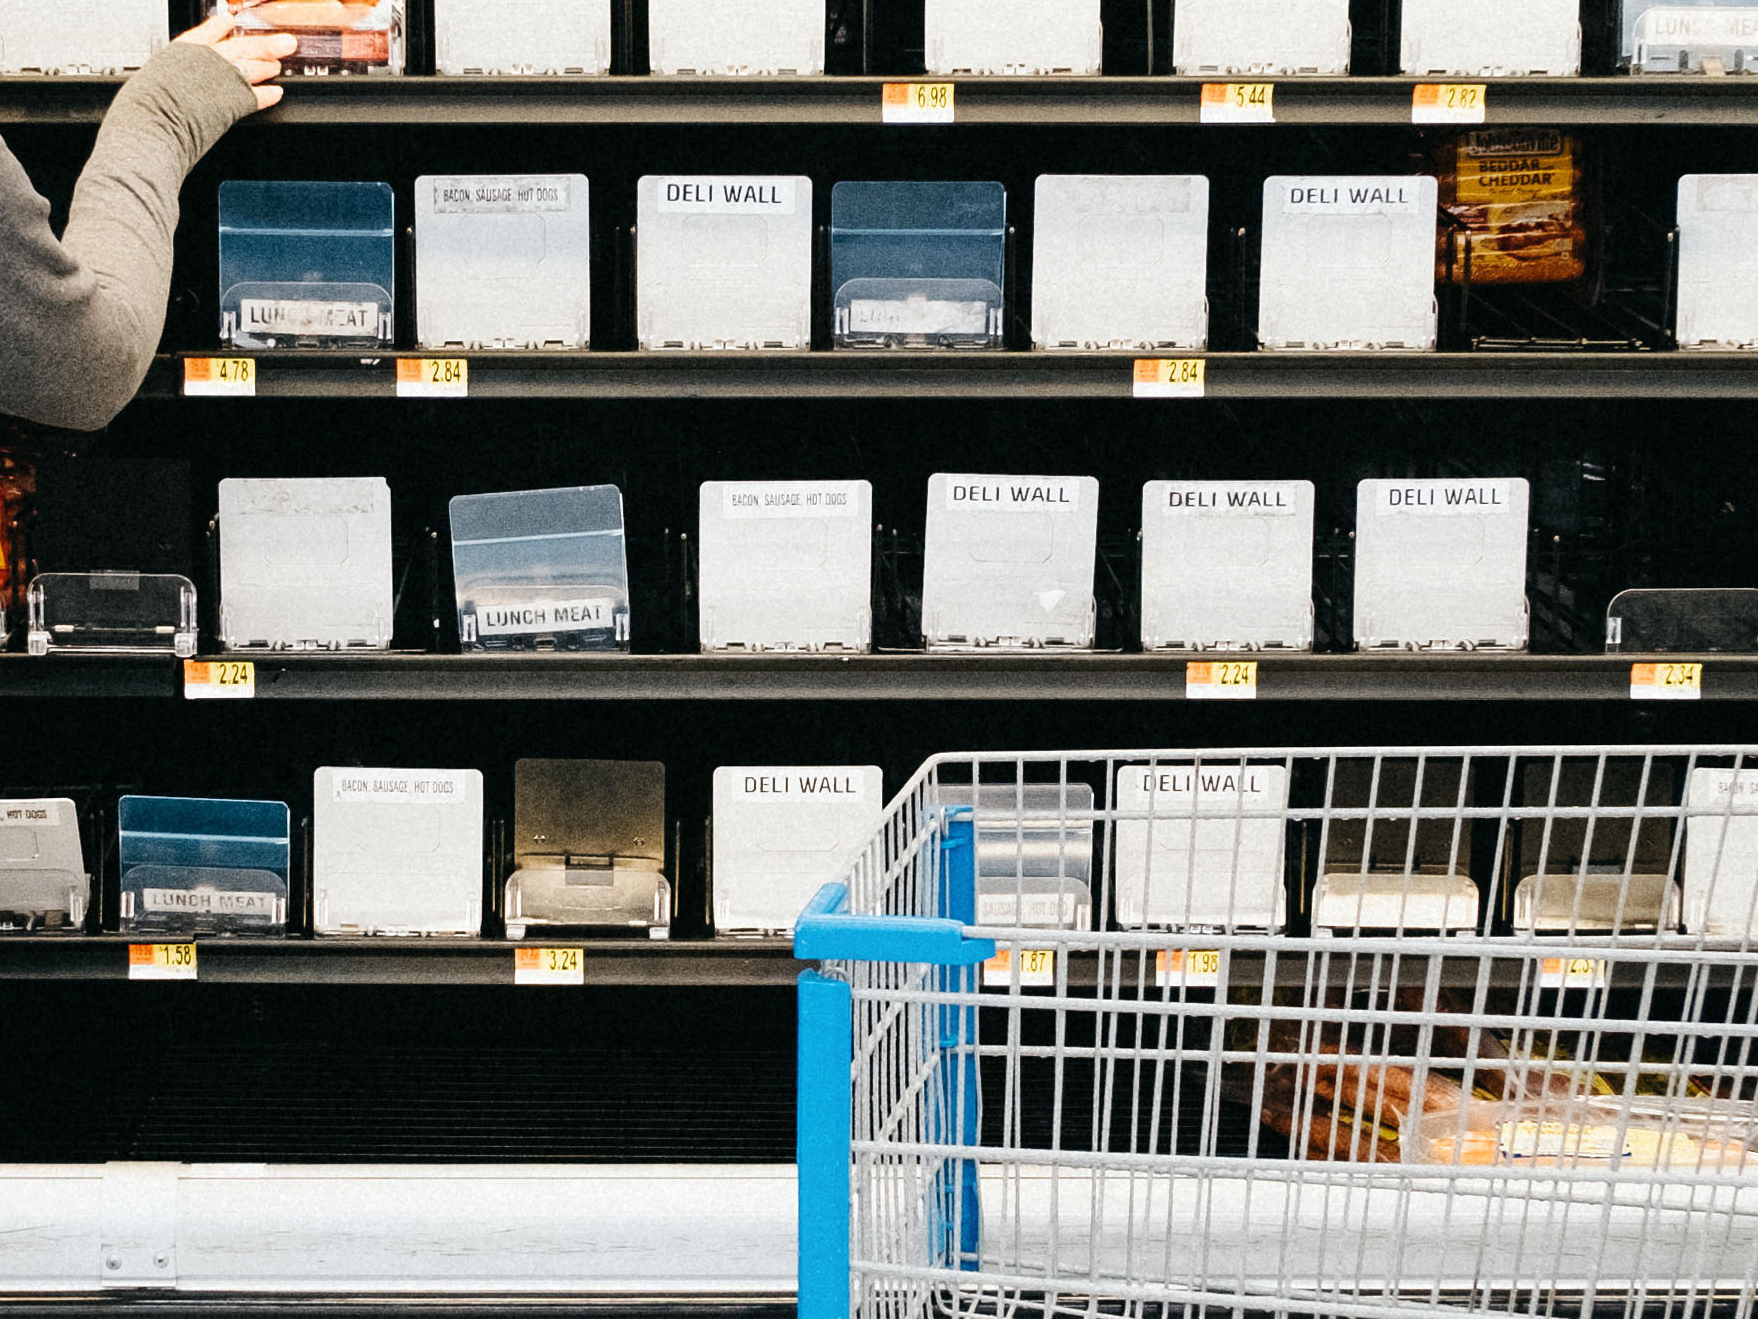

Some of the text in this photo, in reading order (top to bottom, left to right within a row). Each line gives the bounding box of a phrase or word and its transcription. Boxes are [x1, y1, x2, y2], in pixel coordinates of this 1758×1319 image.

[1479, 159, 1541, 173] BEDDAR
[1478, 172, 1552, 187] CHEDDAR
[517, 189, 533, 201] HOT
[537, 189, 558, 201] DOGS
[666, 183, 782, 204] DELI WALL
[1290, 187, 1408, 204] DELI WALL
[807, 493, 821, 505] HOT
[826, 493, 846, 505] DOGS
[953, 485, 1070, 503] DELI WALL
[1168, 490, 1287, 508] DELI WALL
[1388, 487, 1505, 507] DELI WALL
[486, 605, 602, 627] LUNCH MEAT
[414, 781, 429, 793] HOT
[433, 781, 453, 793] DOGS
[744, 776, 859, 794] DELI WALL
[7, 810, 23, 819] HOT
[26, 810, 46, 819] DOGS
[152, 892, 267, 909] LUNCH MEAT
